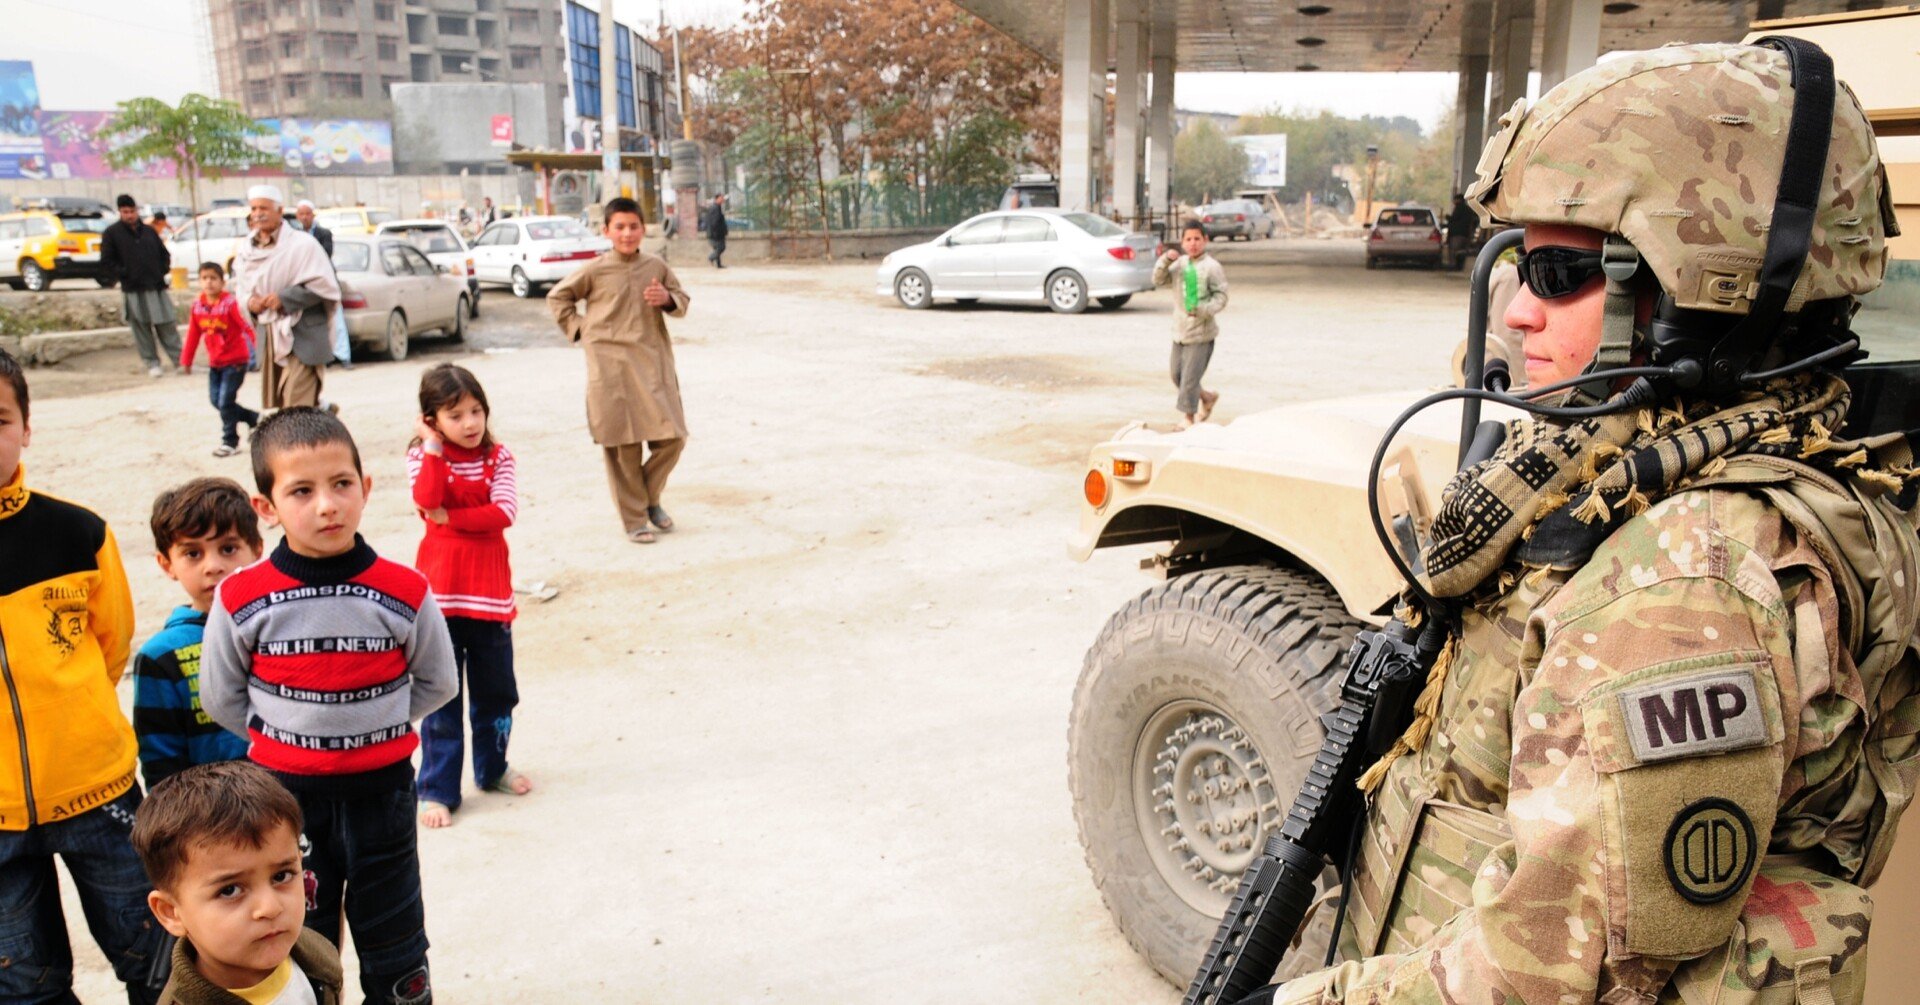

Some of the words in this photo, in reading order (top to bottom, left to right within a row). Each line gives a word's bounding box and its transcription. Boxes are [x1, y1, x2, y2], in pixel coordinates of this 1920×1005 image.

[269, 584, 381, 603] bamspop
[279, 684, 383, 703] bamspop
[1639, 683, 1747, 748] MP
[261, 722, 328, 750] NEWLHL
